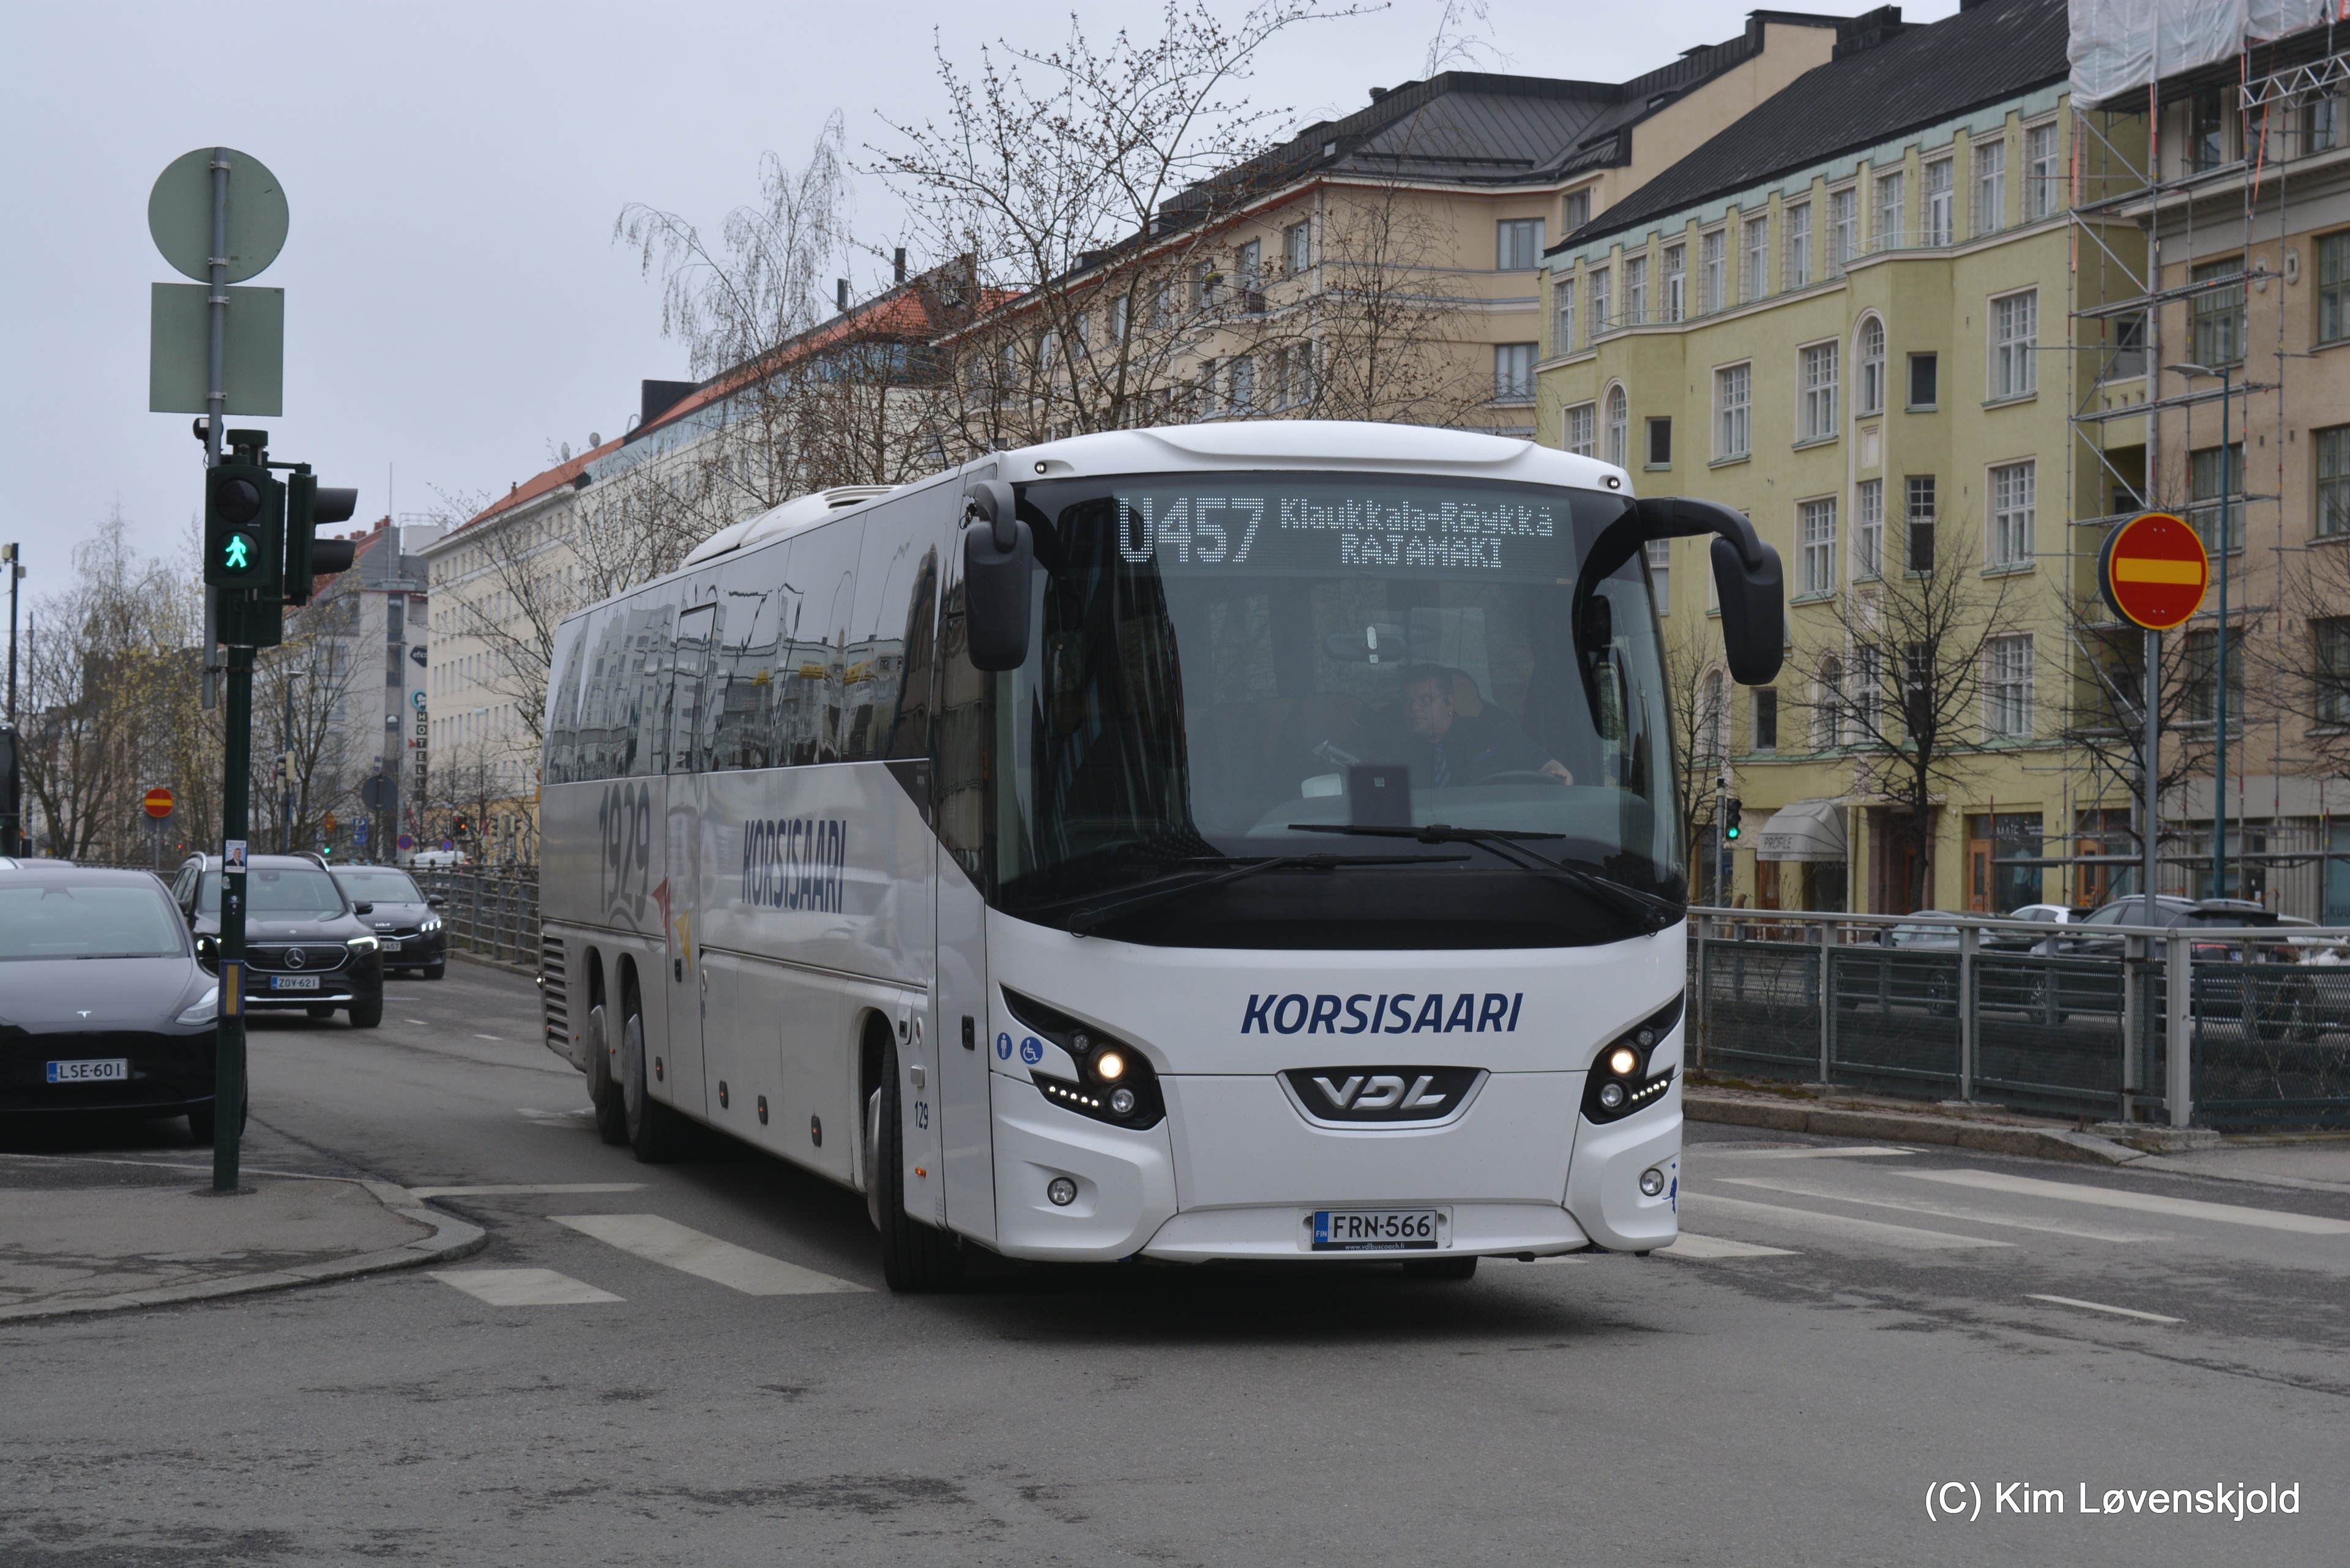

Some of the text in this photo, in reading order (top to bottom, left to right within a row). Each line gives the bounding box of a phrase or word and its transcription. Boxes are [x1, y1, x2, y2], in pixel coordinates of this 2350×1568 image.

[1119, 498, 1553, 562] U457 Klaukkala-Röykkä
[1341, 534, 1502, 568] RAJAMÄKI
[599, 782, 650, 922] 1929
[1764, 837, 1792, 849] PROFILE
[742, 818, 846, 914] KORSISAARI
[1240, 993, 1524, 1034] KORSISAARI
[60, 1063, 119, 1078] LSE-601
[1312, 1075, 1447, 1110] VDL
[915, 1100, 928, 1130] 129
[1333, 1215, 1430, 1238] FRN-566
